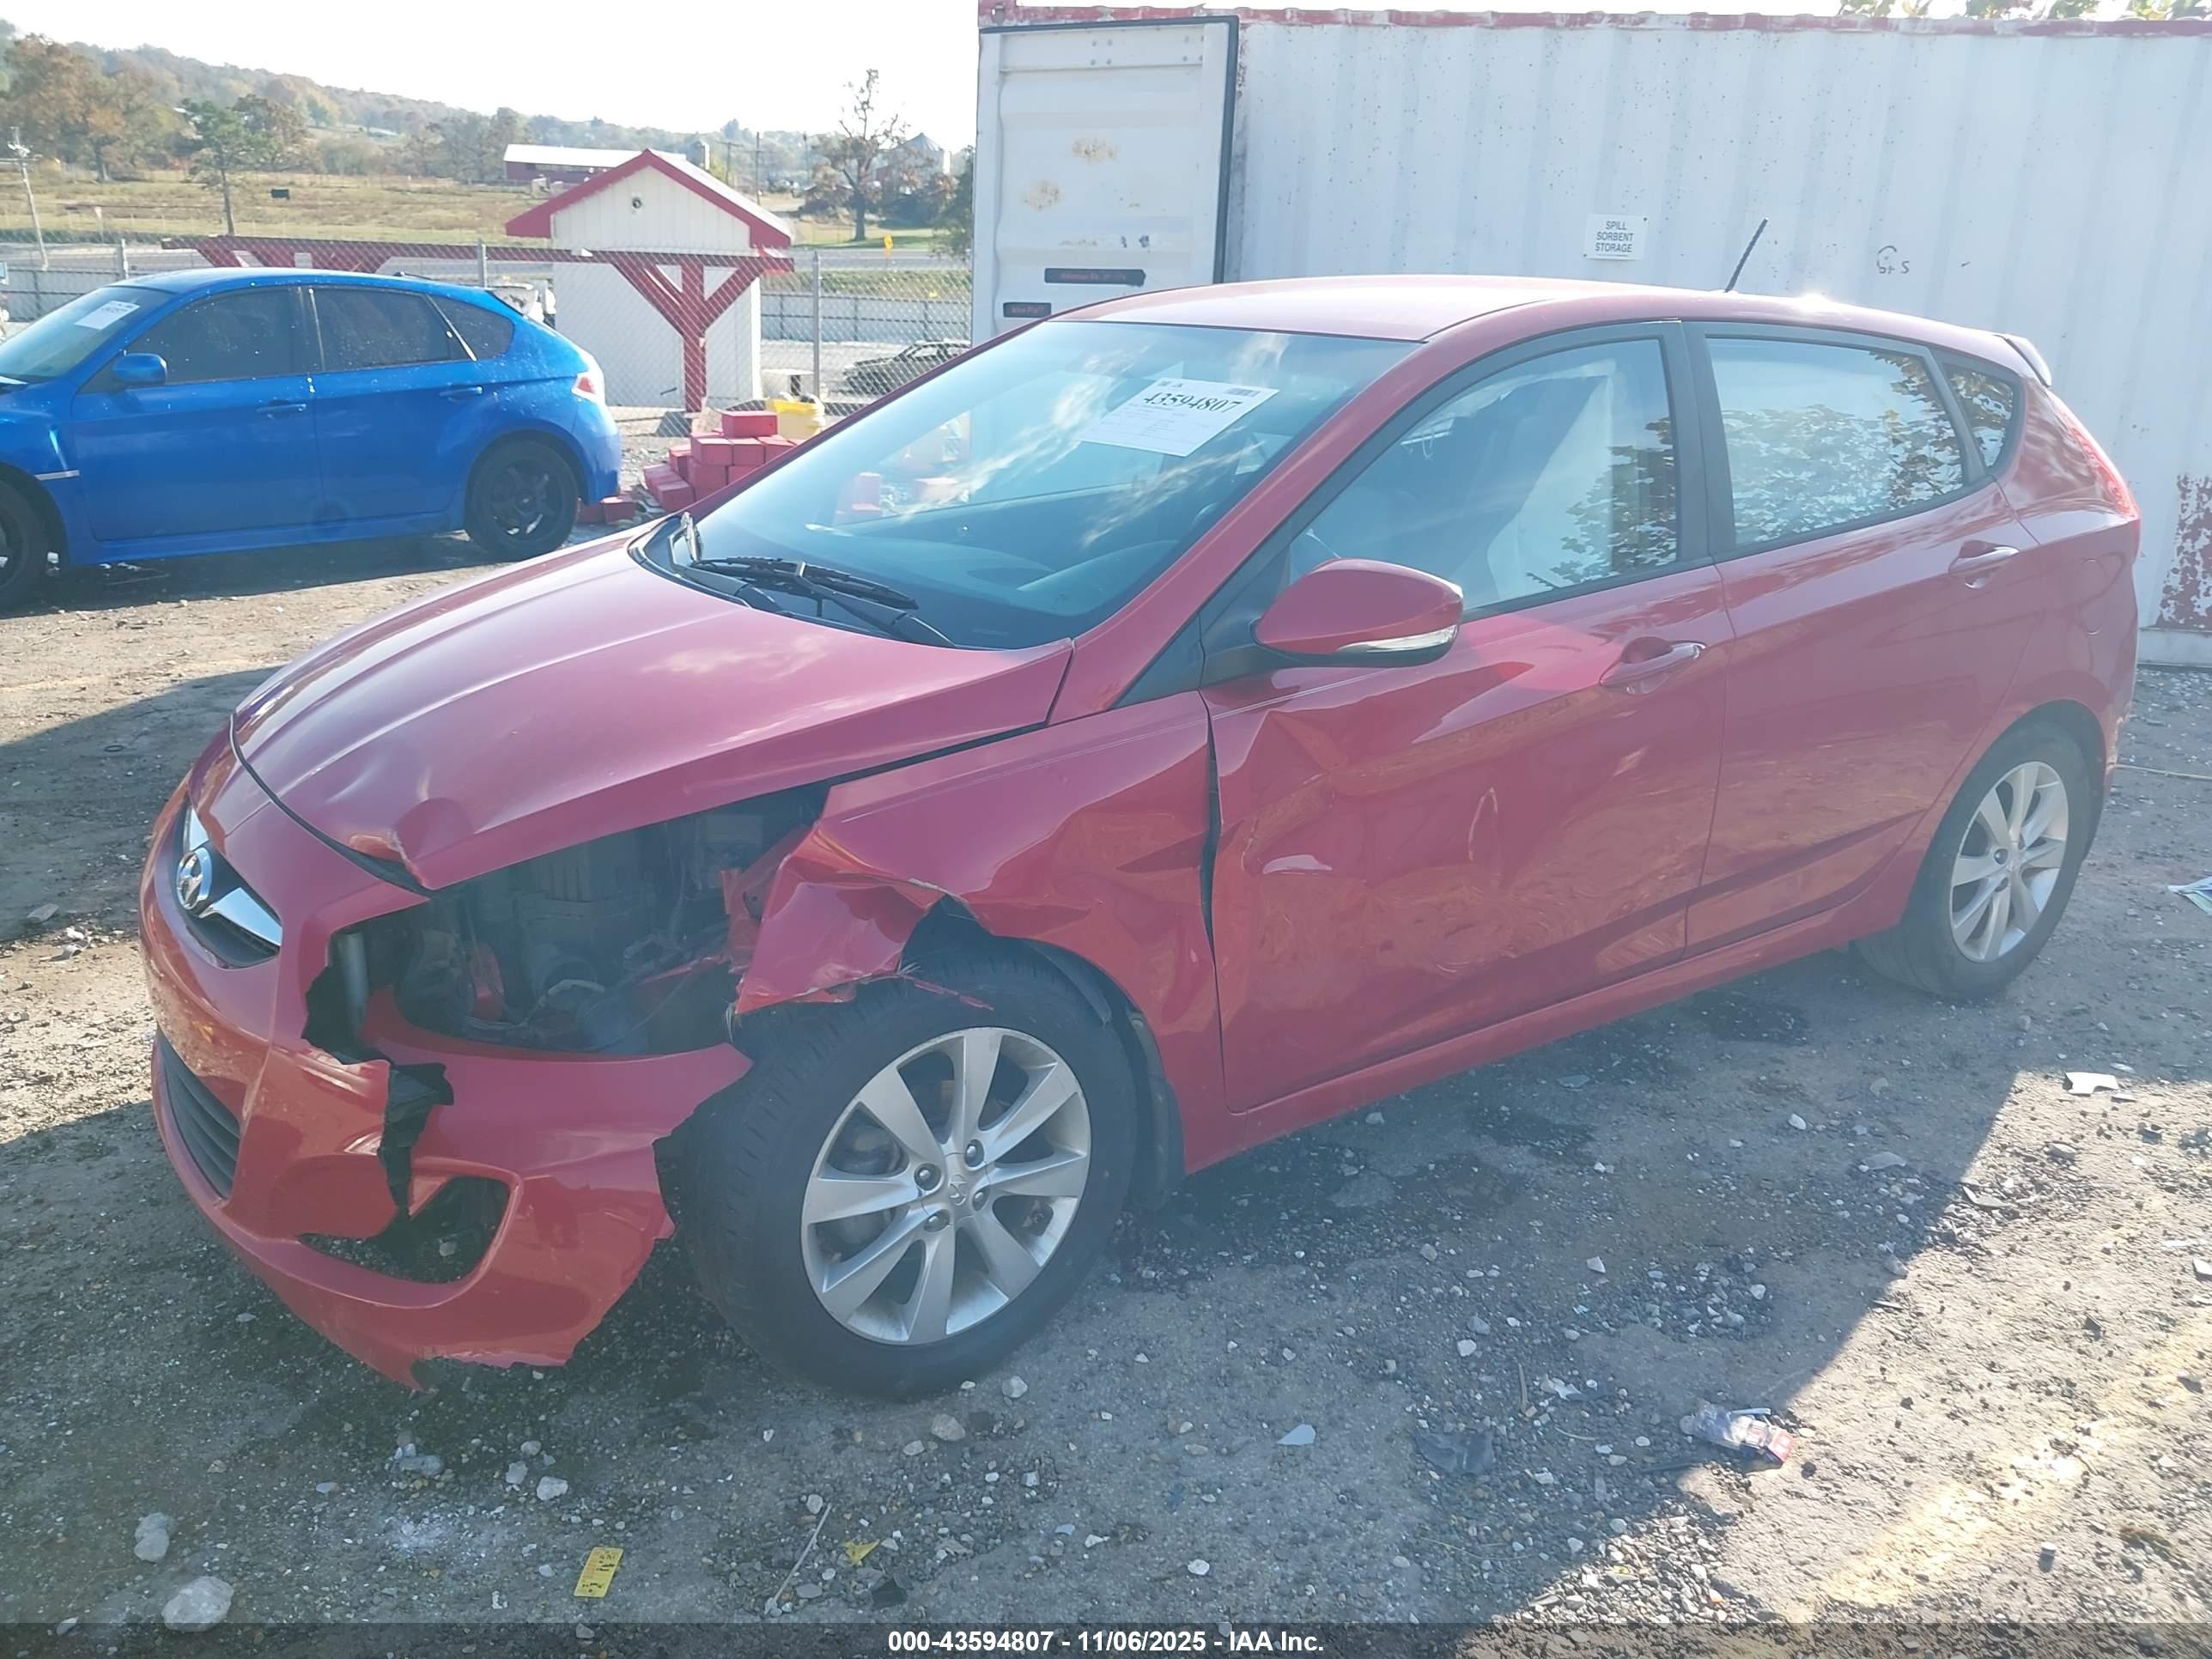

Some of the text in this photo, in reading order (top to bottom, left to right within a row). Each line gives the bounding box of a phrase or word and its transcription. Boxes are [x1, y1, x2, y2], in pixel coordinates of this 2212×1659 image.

[1605, 220, 1628, 231] SPILL
[1596, 231, 1635, 241] SORBENT
[1595, 242, 1633, 252] STORAGE
[1144, 392, 1243, 412] 43594807
